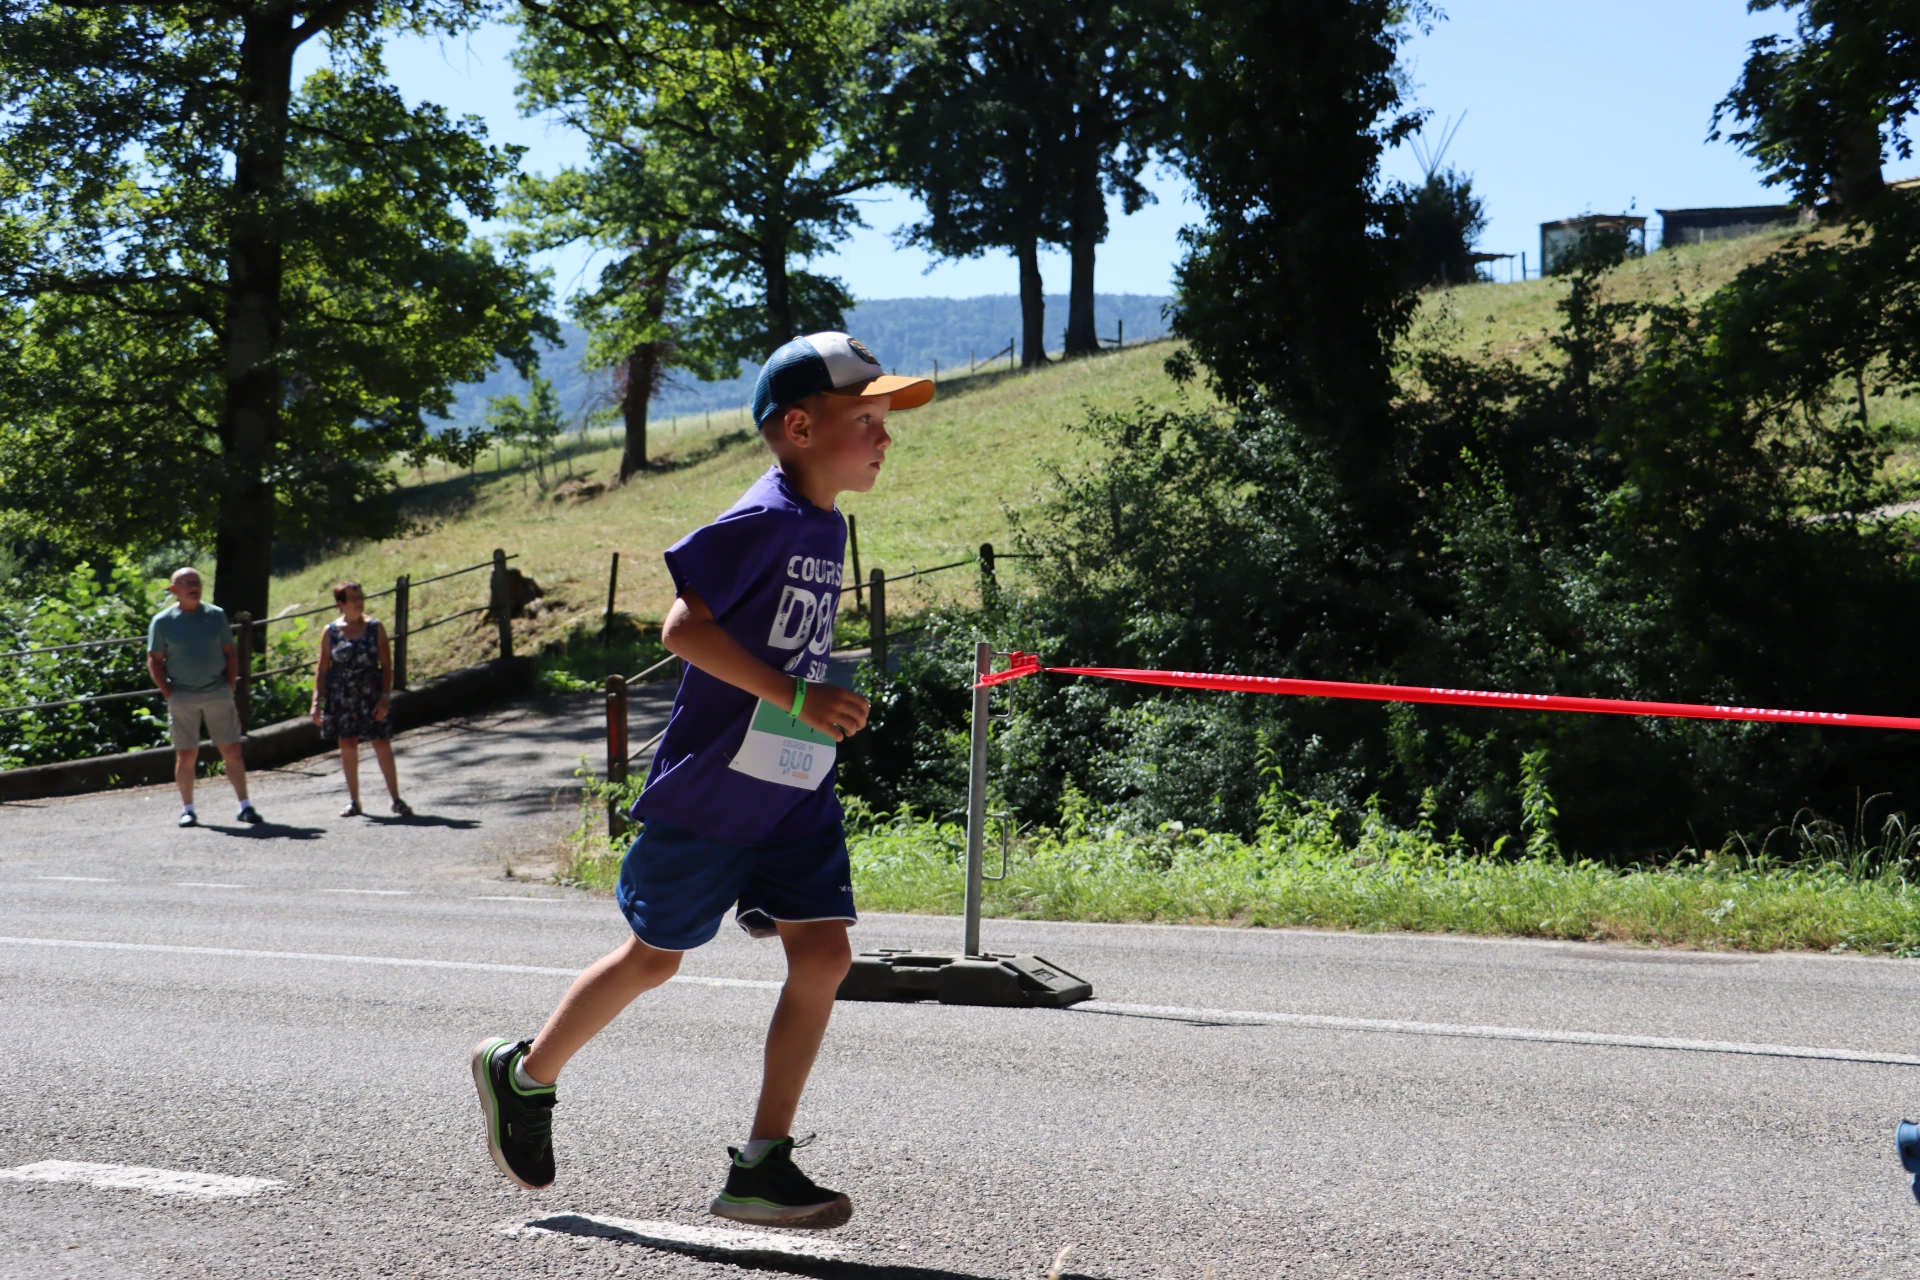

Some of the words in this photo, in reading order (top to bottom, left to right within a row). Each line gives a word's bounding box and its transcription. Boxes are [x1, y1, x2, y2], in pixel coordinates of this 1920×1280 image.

[787, 555, 843, 587] COURS
[767, 585, 839, 656] DU
[778, 748, 813, 772] DUO
